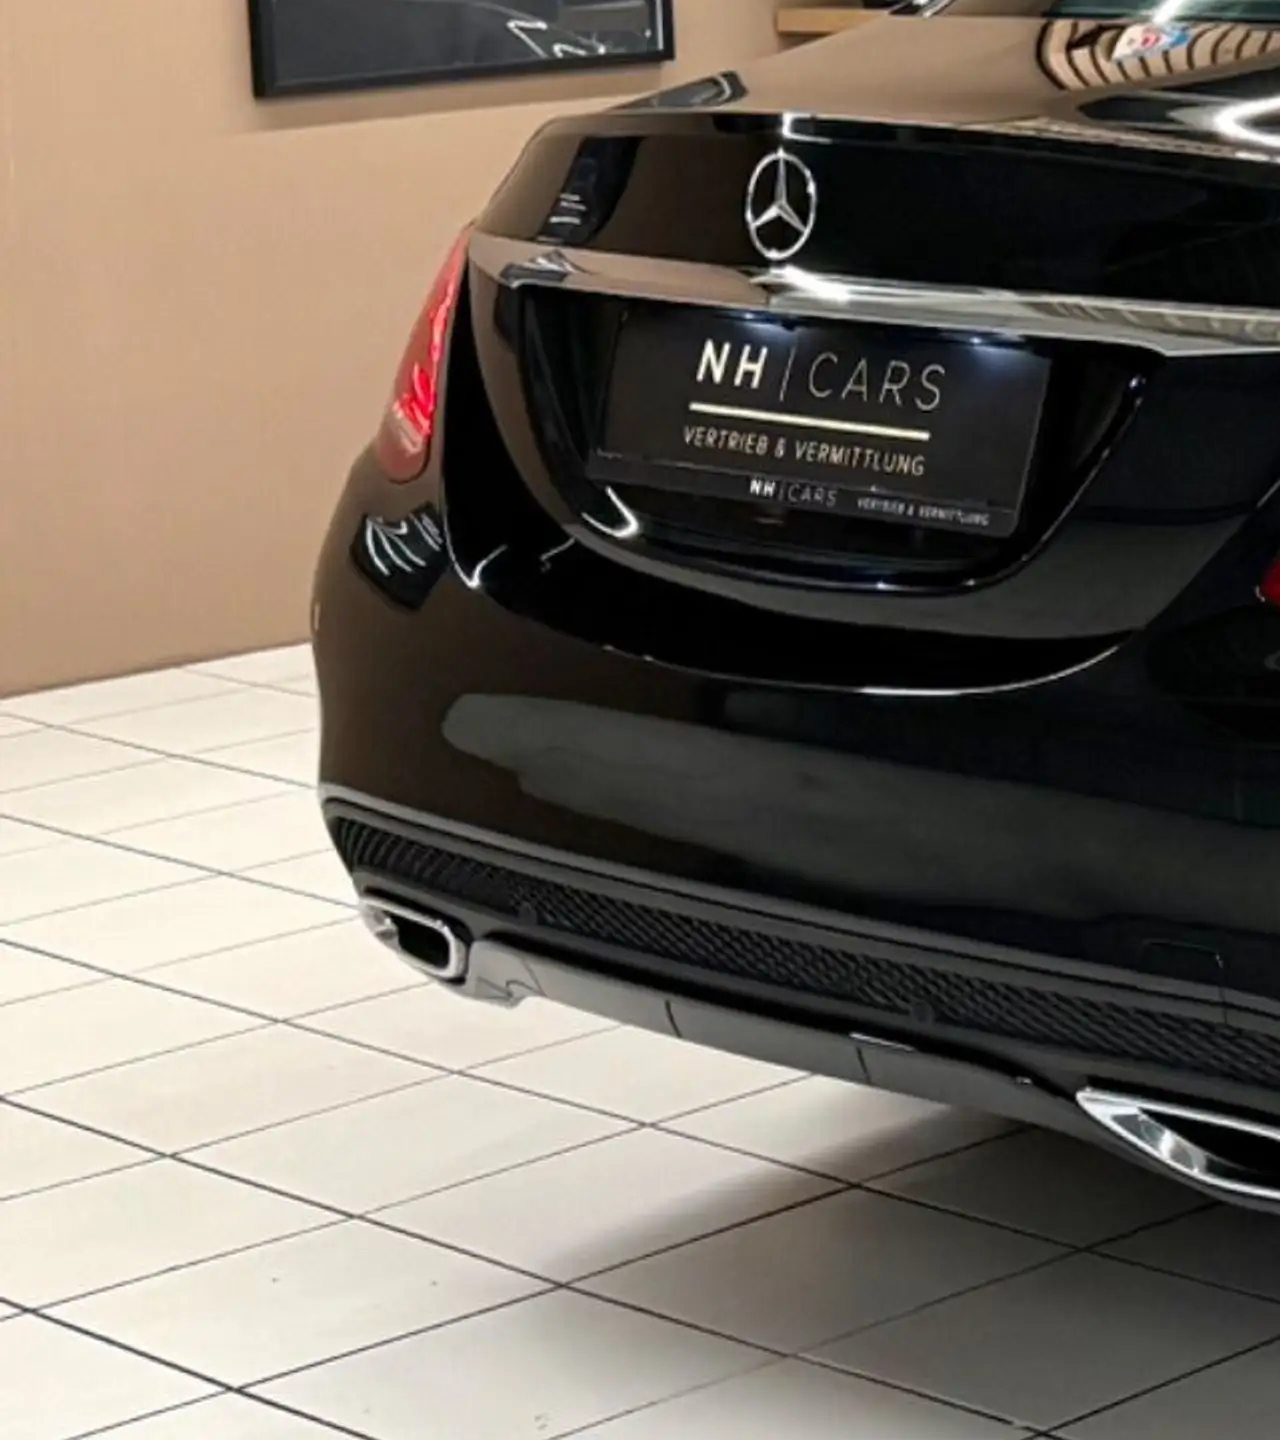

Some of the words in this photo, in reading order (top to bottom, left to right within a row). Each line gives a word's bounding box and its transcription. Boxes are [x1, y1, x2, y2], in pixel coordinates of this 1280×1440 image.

[695, 338, 768, 390] NH
[807, 351, 946, 413] CARS
[683, 425, 769, 458] VERTRIEB
[773, 440, 786, 460] &
[794, 440, 926, 478] VERMITTLUNG
[749, 478, 776, 498] NH
[787, 484, 839, 507] CARS
